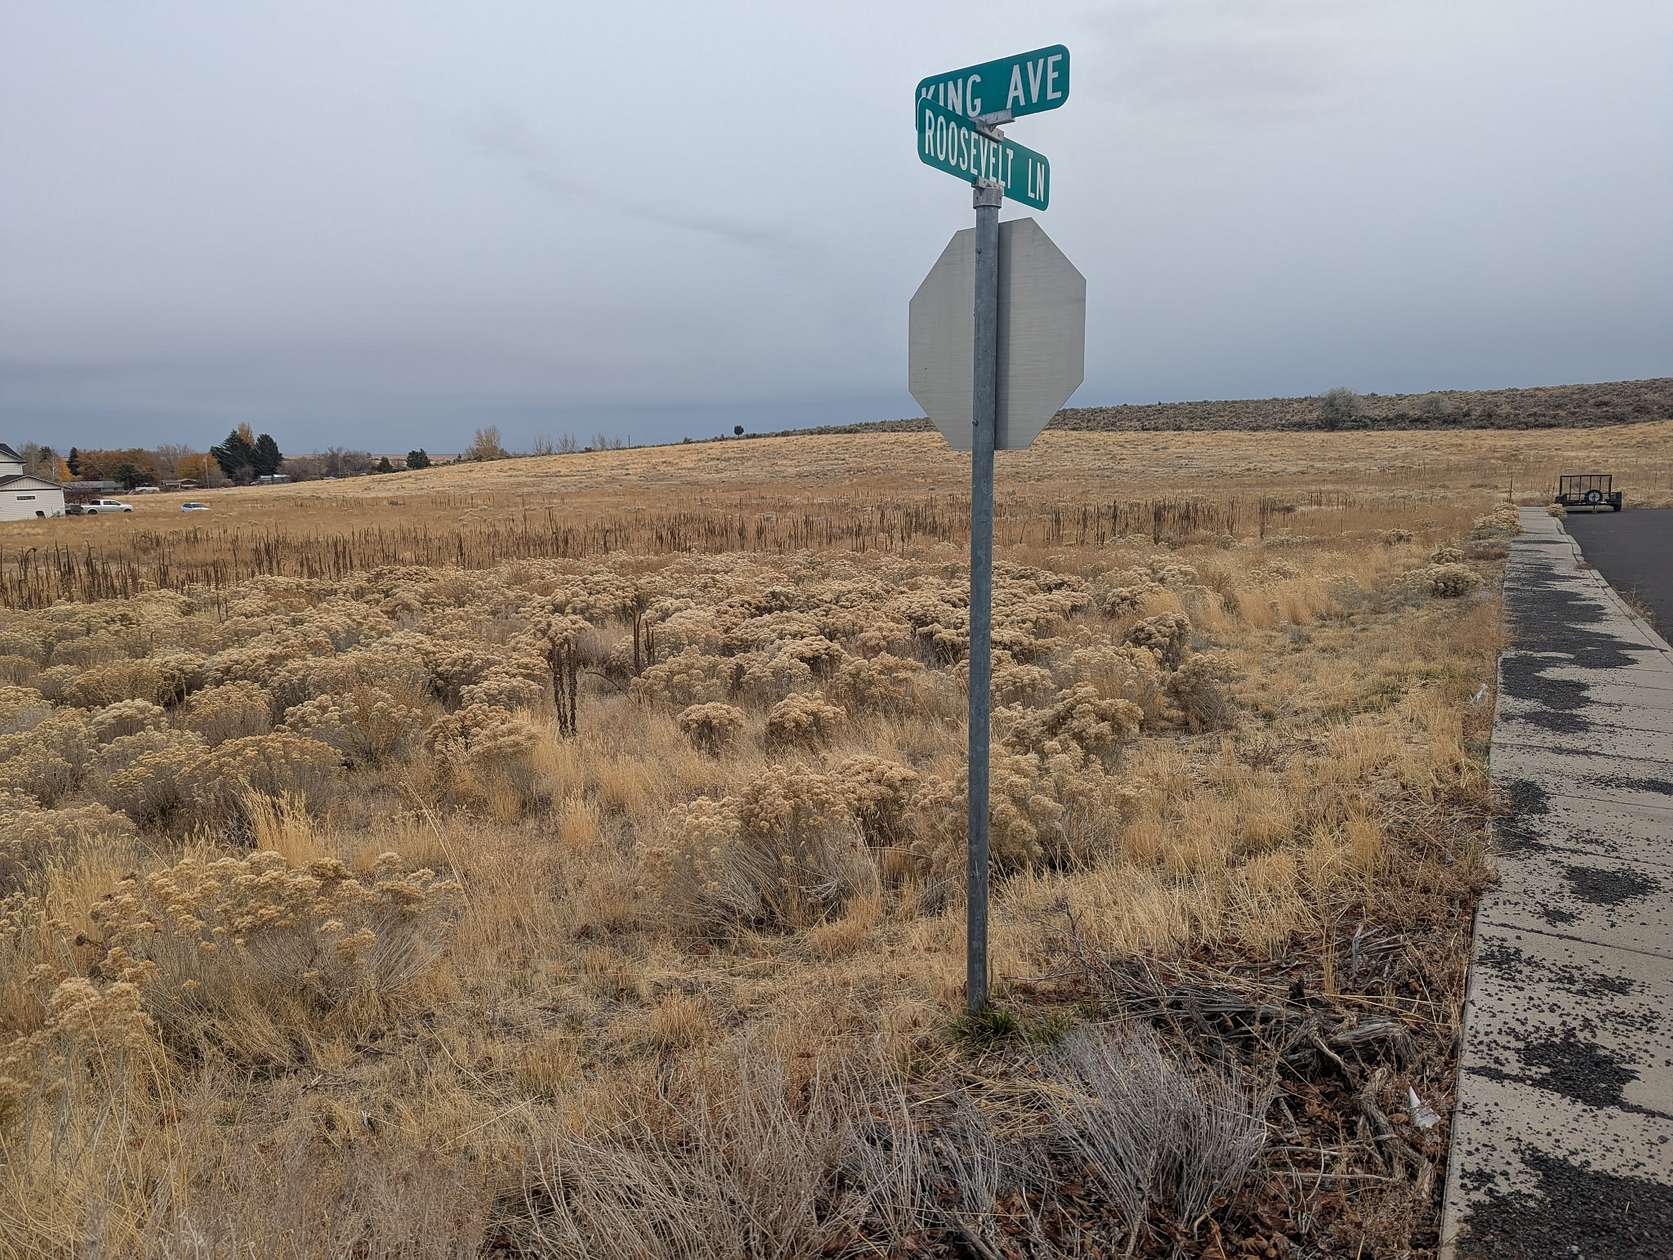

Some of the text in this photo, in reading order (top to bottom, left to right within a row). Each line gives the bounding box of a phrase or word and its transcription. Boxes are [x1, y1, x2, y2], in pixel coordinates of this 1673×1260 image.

[1006, 54, 1062, 109] AVE
[925, 109, 1045, 202] ROOSEVELT LN
